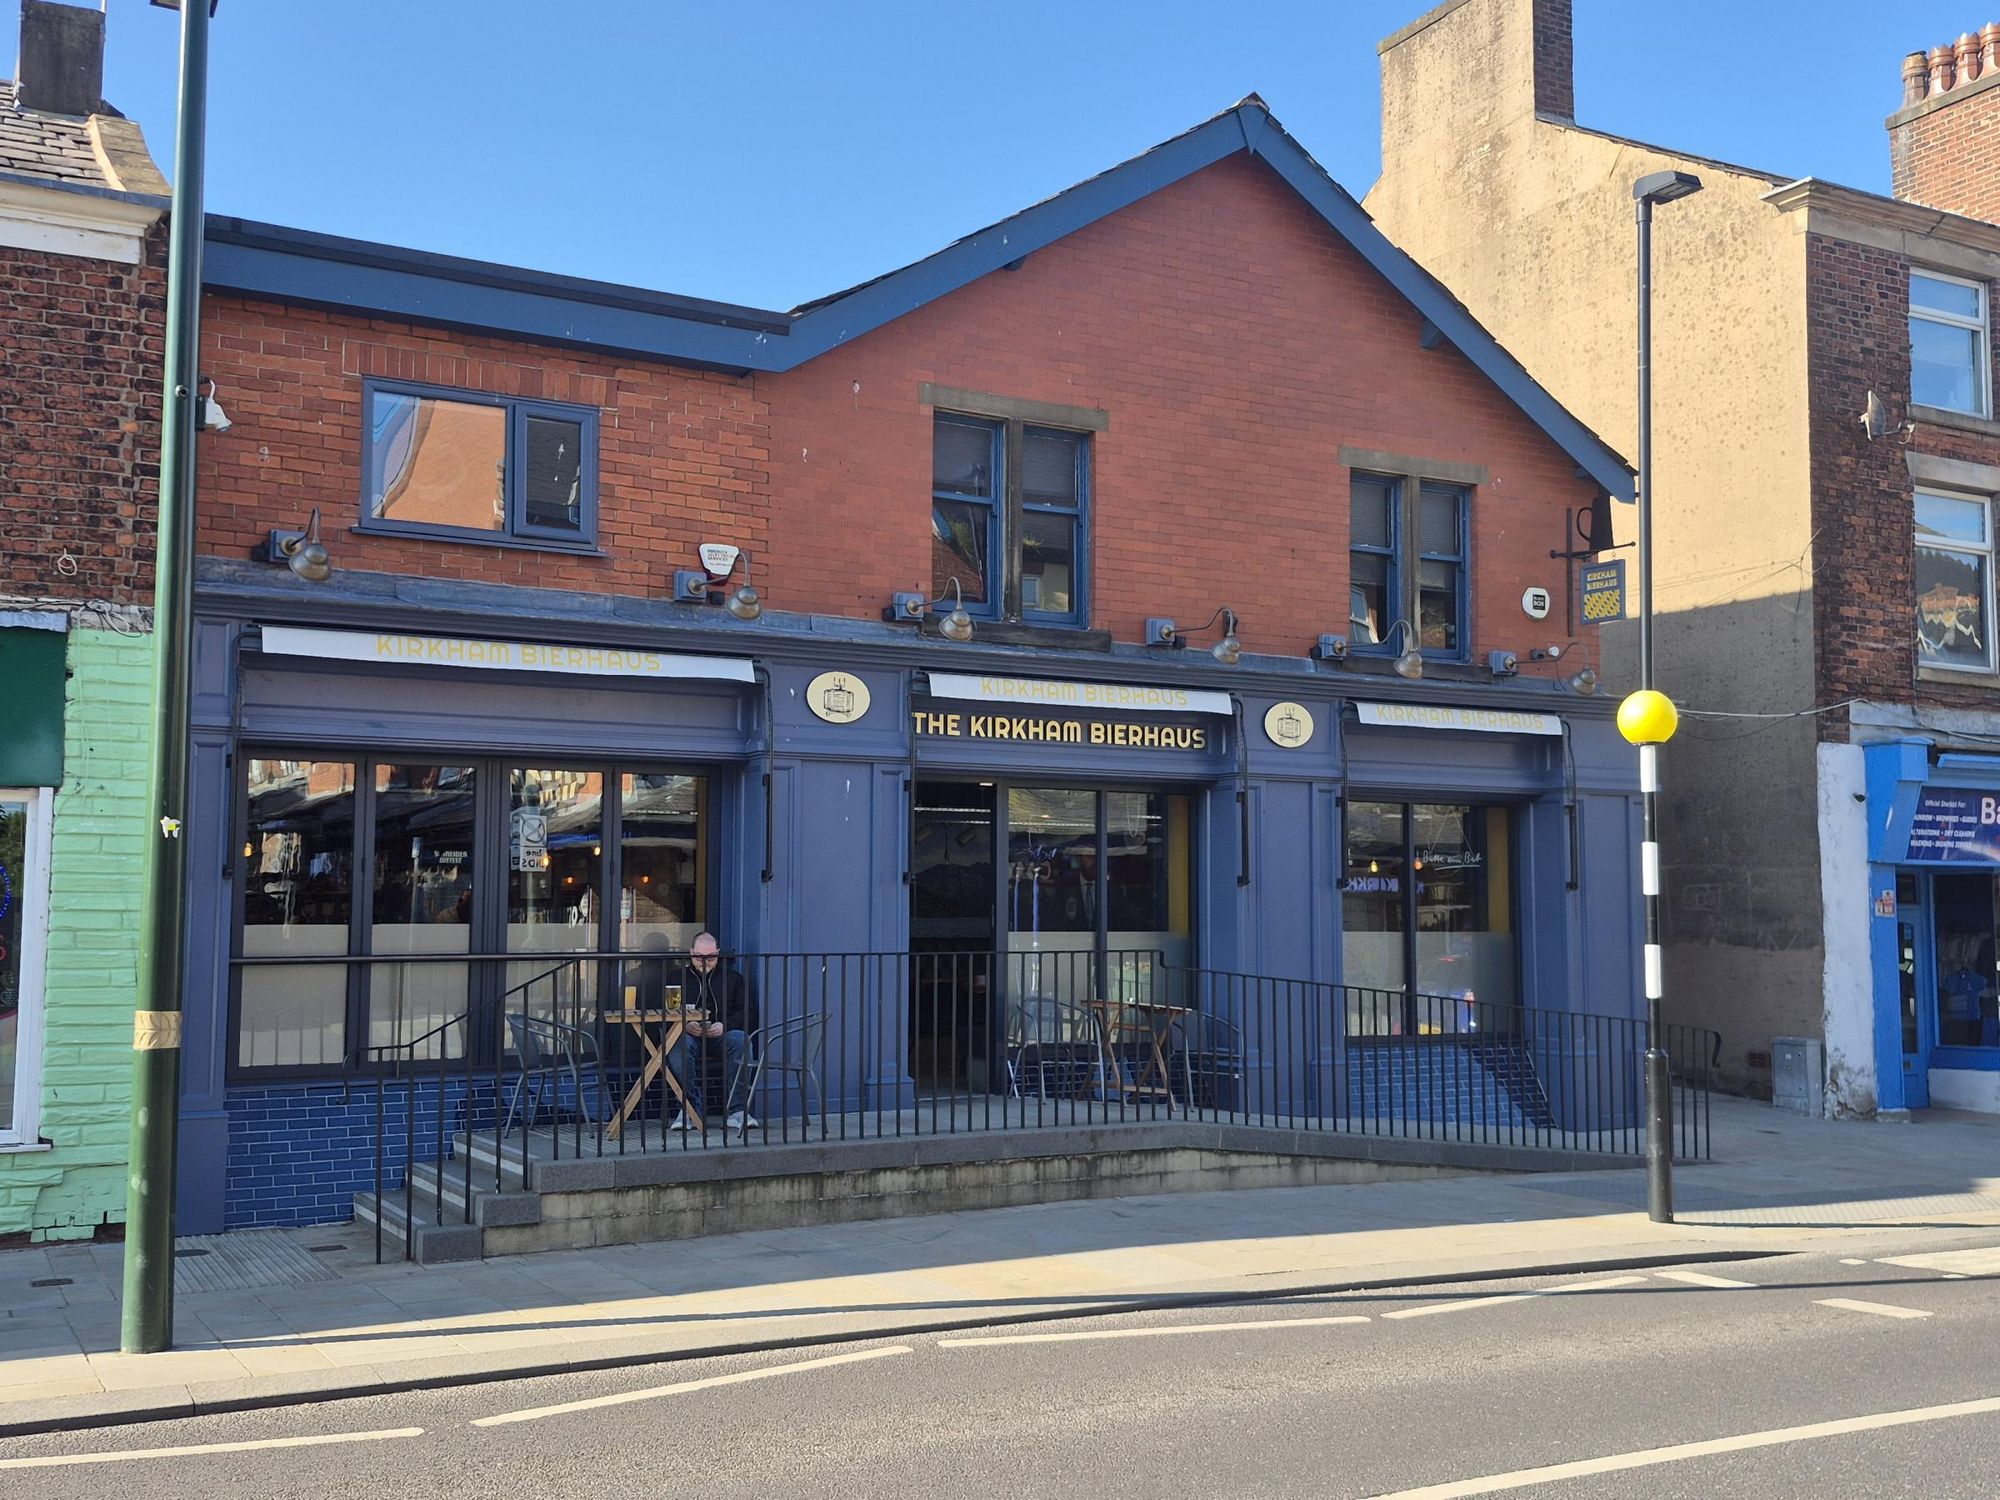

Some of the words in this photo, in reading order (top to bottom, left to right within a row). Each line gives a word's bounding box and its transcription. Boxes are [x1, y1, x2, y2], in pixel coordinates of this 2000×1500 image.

[1587, 570, 1617, 581] KIRKHAM
[1587, 579, 1617, 590] BIERHAUS
[376, 634, 511, 663] KIRKHAM
[520, 644, 661, 672] BIERHAUS
[981, 677, 1078, 699] KIRKHAM
[1084, 684, 1188, 706] BIERHAUS
[913, 711, 961, 736] THE
[970, 715, 1082, 743] KIRKHAM
[1090, 722, 1206, 749] BIERHAUS
[1376, 704, 1456, 724] KIRKHAM
[1460, 710, 1544, 730] BIERHAUS
